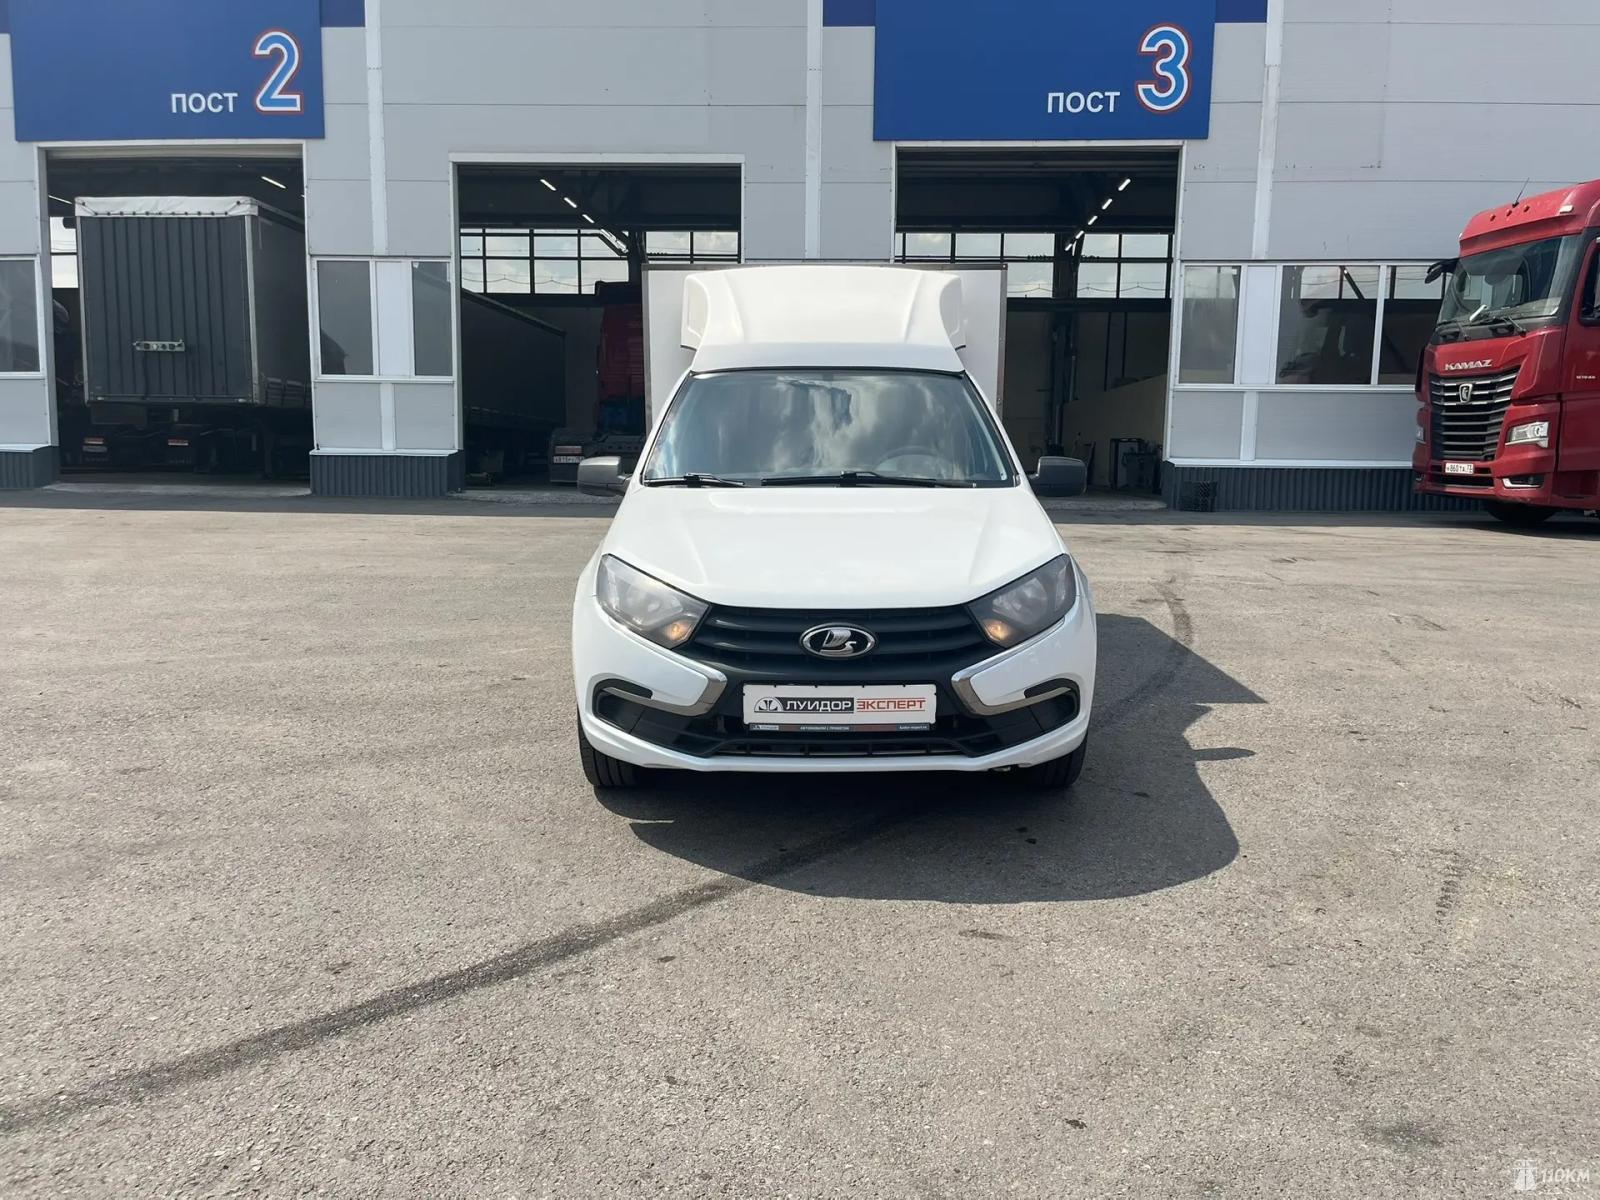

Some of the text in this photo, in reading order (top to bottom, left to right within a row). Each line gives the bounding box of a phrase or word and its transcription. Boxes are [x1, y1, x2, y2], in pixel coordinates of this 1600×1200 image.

[171, 29, 303, 114] ПОСТ 2
[1047, 22, 1192, 114] ПОСТ 3
[1444, 358, 1493, 371] KAMAZ
[785, 699, 926, 712] ЛУИДОР ЭКСПЕРТ
